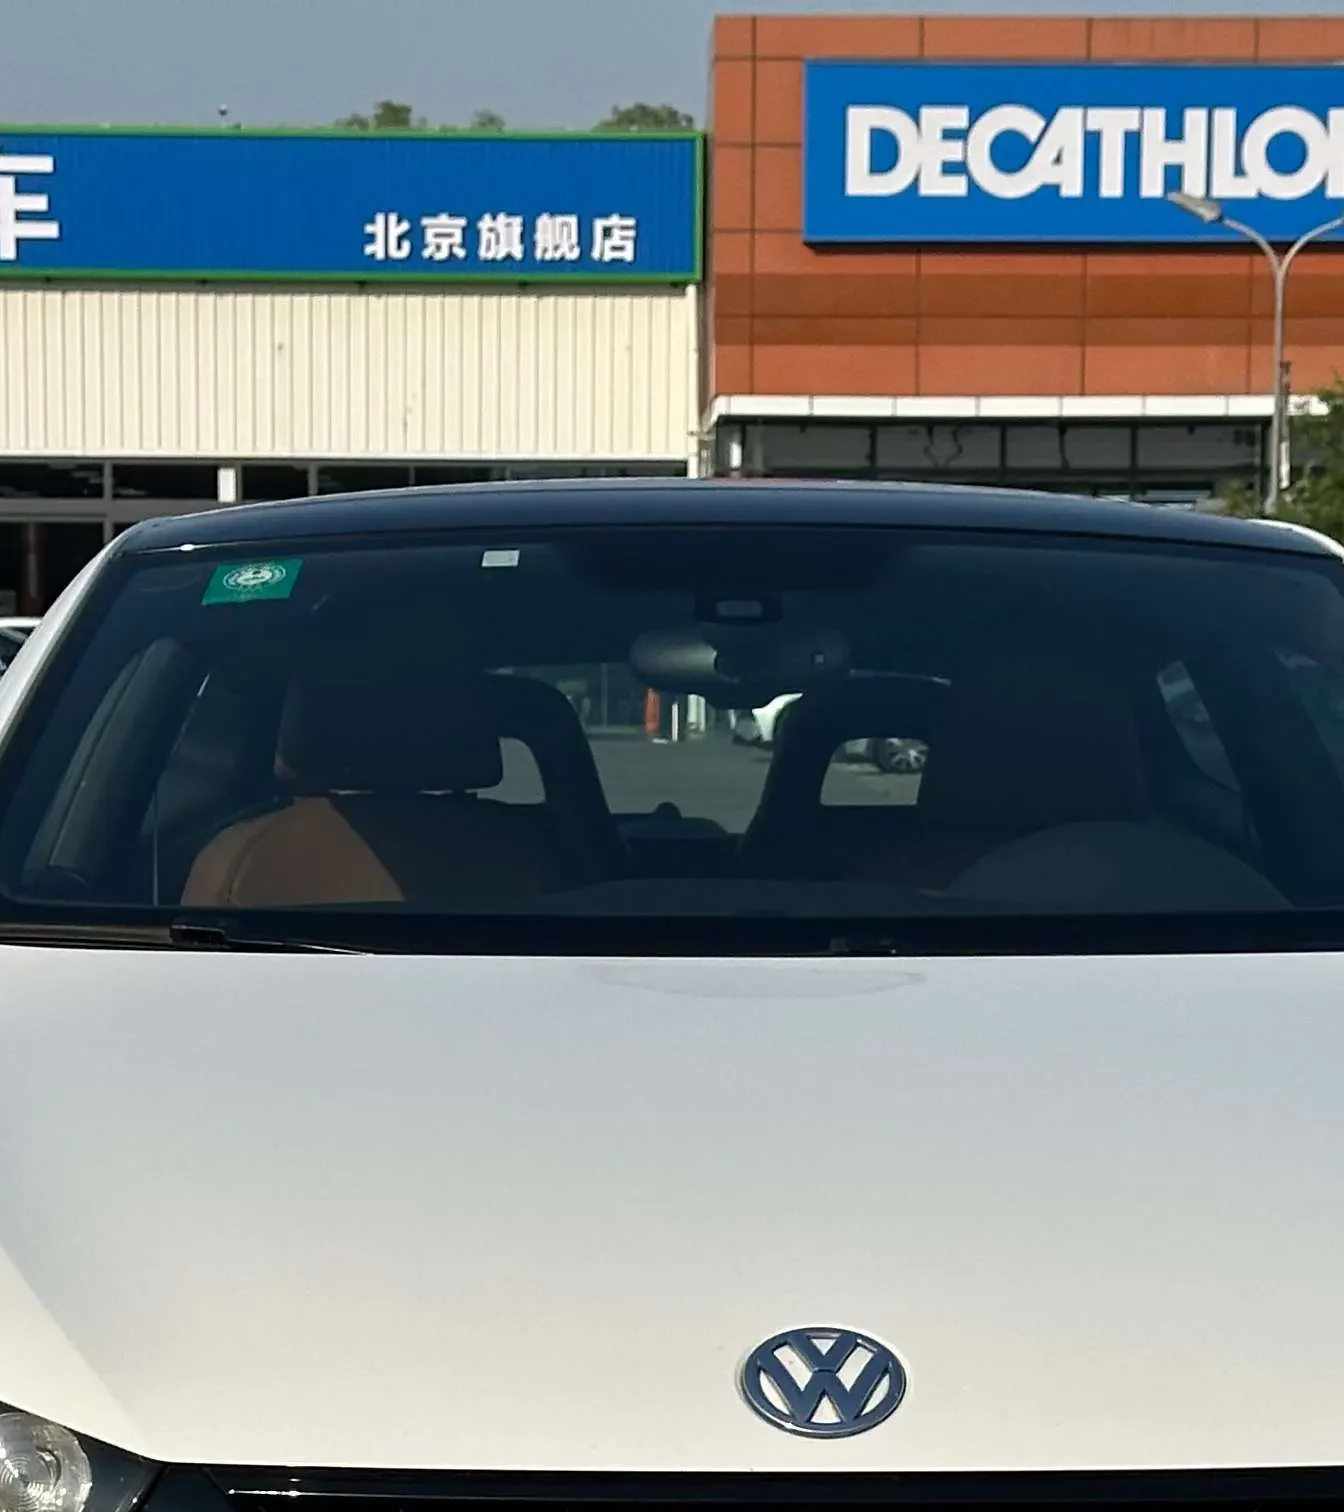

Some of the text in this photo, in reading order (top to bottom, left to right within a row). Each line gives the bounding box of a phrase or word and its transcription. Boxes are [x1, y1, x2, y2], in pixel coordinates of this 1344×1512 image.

[363, 211, 638, 263] 北京旗舰店
